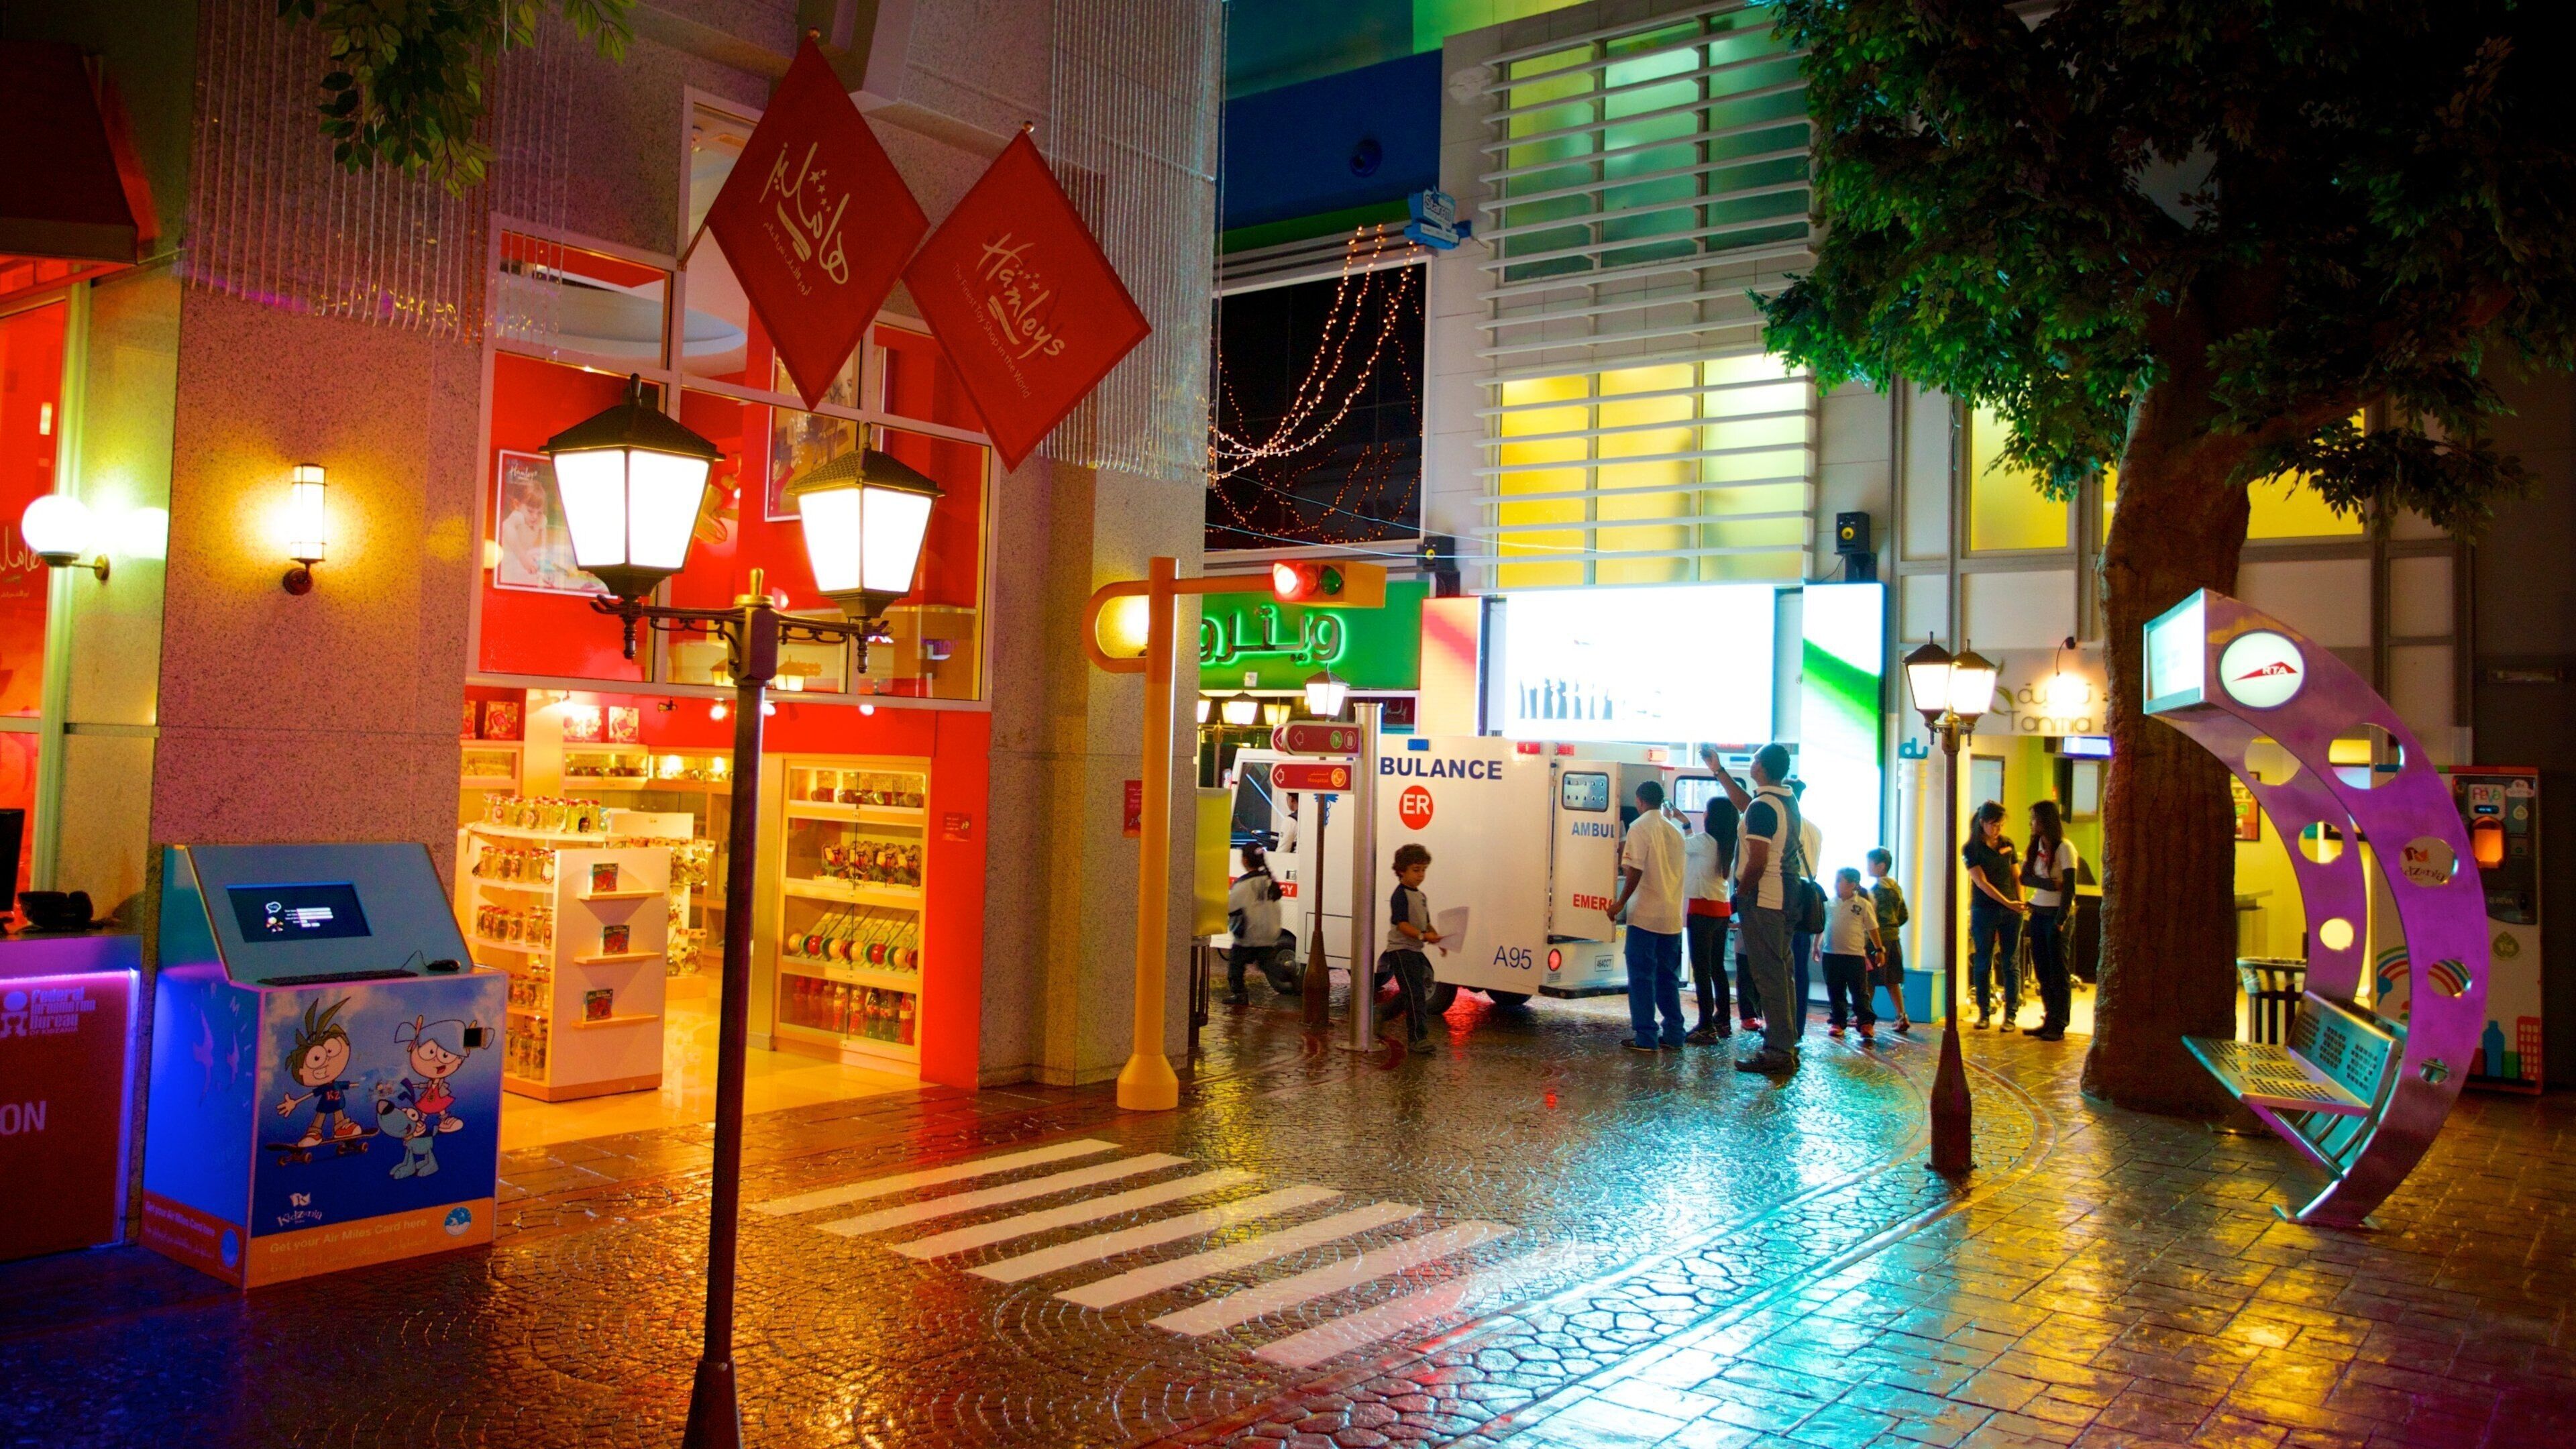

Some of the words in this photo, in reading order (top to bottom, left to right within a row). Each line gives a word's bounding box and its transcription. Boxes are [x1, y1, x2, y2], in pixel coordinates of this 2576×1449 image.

[759, 142, 849, 284] هامليز
[977, 232, 1065, 360] Hamleys
[960, 278, 977, 308] Finest
[975, 305, 986, 323] Toy
[983, 321, 1000, 347] Shop
[998, 345, 1006, 358] in
[1004, 355, 1016, 374] the
[1014, 369, 1032, 399] World
[2262, 664, 2289, 676] RTA
[2004, 710, 2092, 733] Tanmia
[1379, 757, 1503, 780] BULANCE
[1403, 794, 1430, 815] ER
[1493, 945, 1532, 970] A95
[0, 1100, 47, 1136] ON
[270, 1242, 291, 1254] Get
[292, 1237, 320, 1251] your
[323, 1232, 339, 1244] Air
[342, 1227, 371, 1240] Miles
[374, 1221, 400, 1235] Card
[402, 1217, 427, 1230] here
